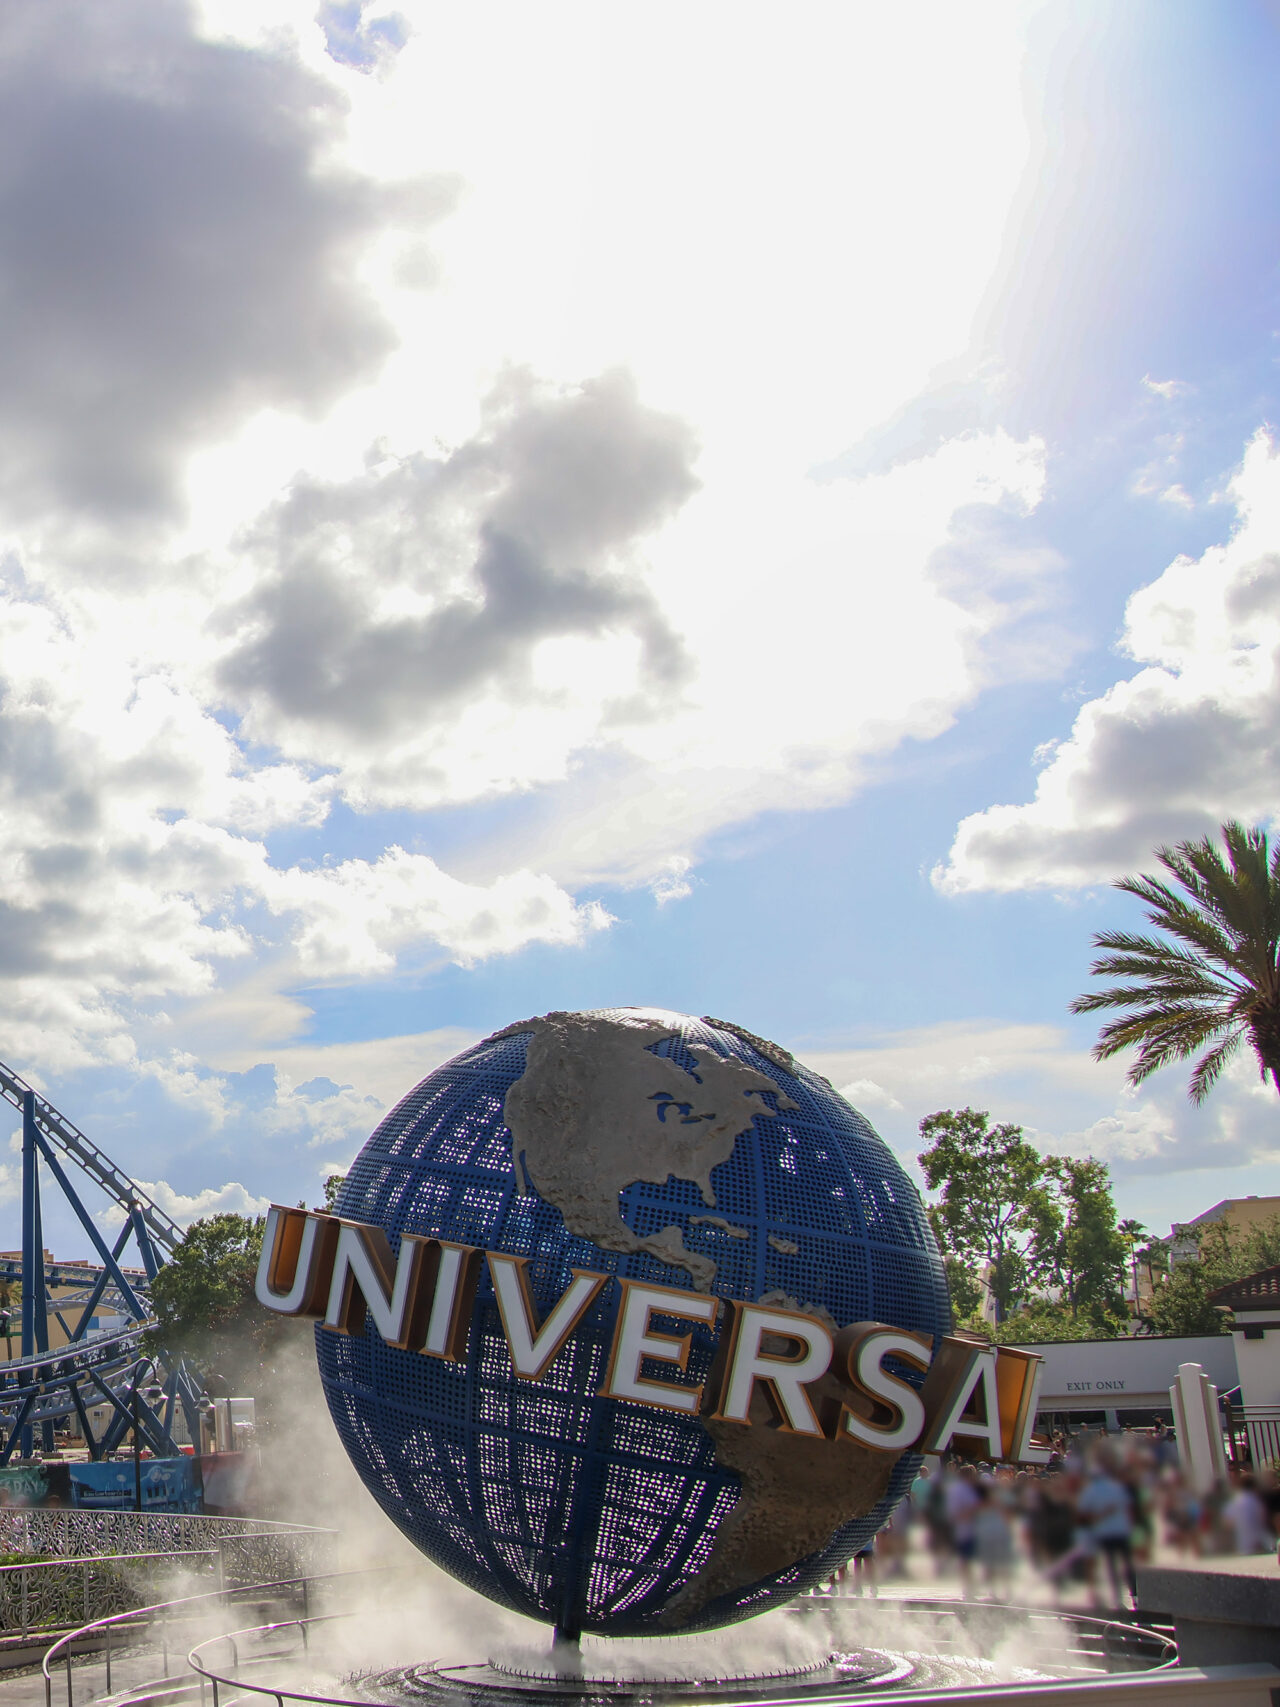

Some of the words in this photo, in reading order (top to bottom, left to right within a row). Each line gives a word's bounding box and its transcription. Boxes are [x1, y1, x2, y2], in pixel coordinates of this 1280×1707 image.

[254, 1205, 1053, 1465] UNIVERSAL
[1066, 1382, 1091, 1391] EXIT
[1095, 1381, 1125, 1390] ONLY
